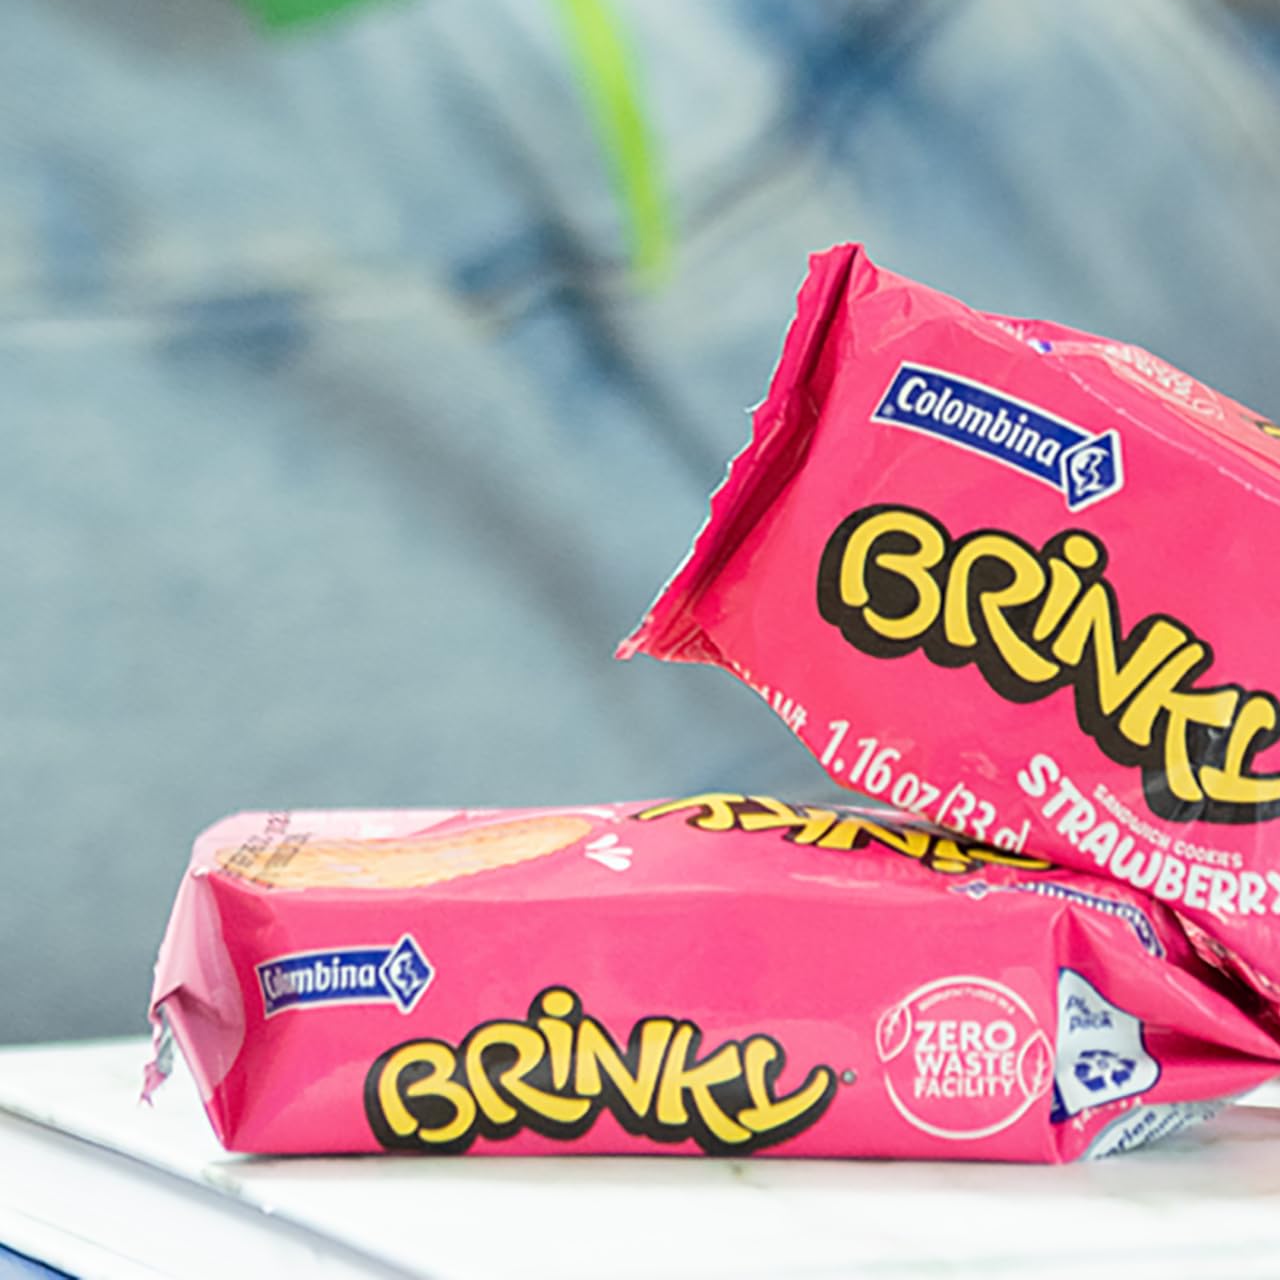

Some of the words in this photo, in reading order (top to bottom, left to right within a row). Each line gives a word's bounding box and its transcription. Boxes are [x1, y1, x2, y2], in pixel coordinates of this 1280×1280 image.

[897, 376, 1062, 468] Colombina
[820, 719, 902, 794] 1.16
[915, 1019, 1017, 1053] ZERO
[914, 1051, 1016, 1078] WASTE
[914, 1076, 1016, 1100] FACILITY
